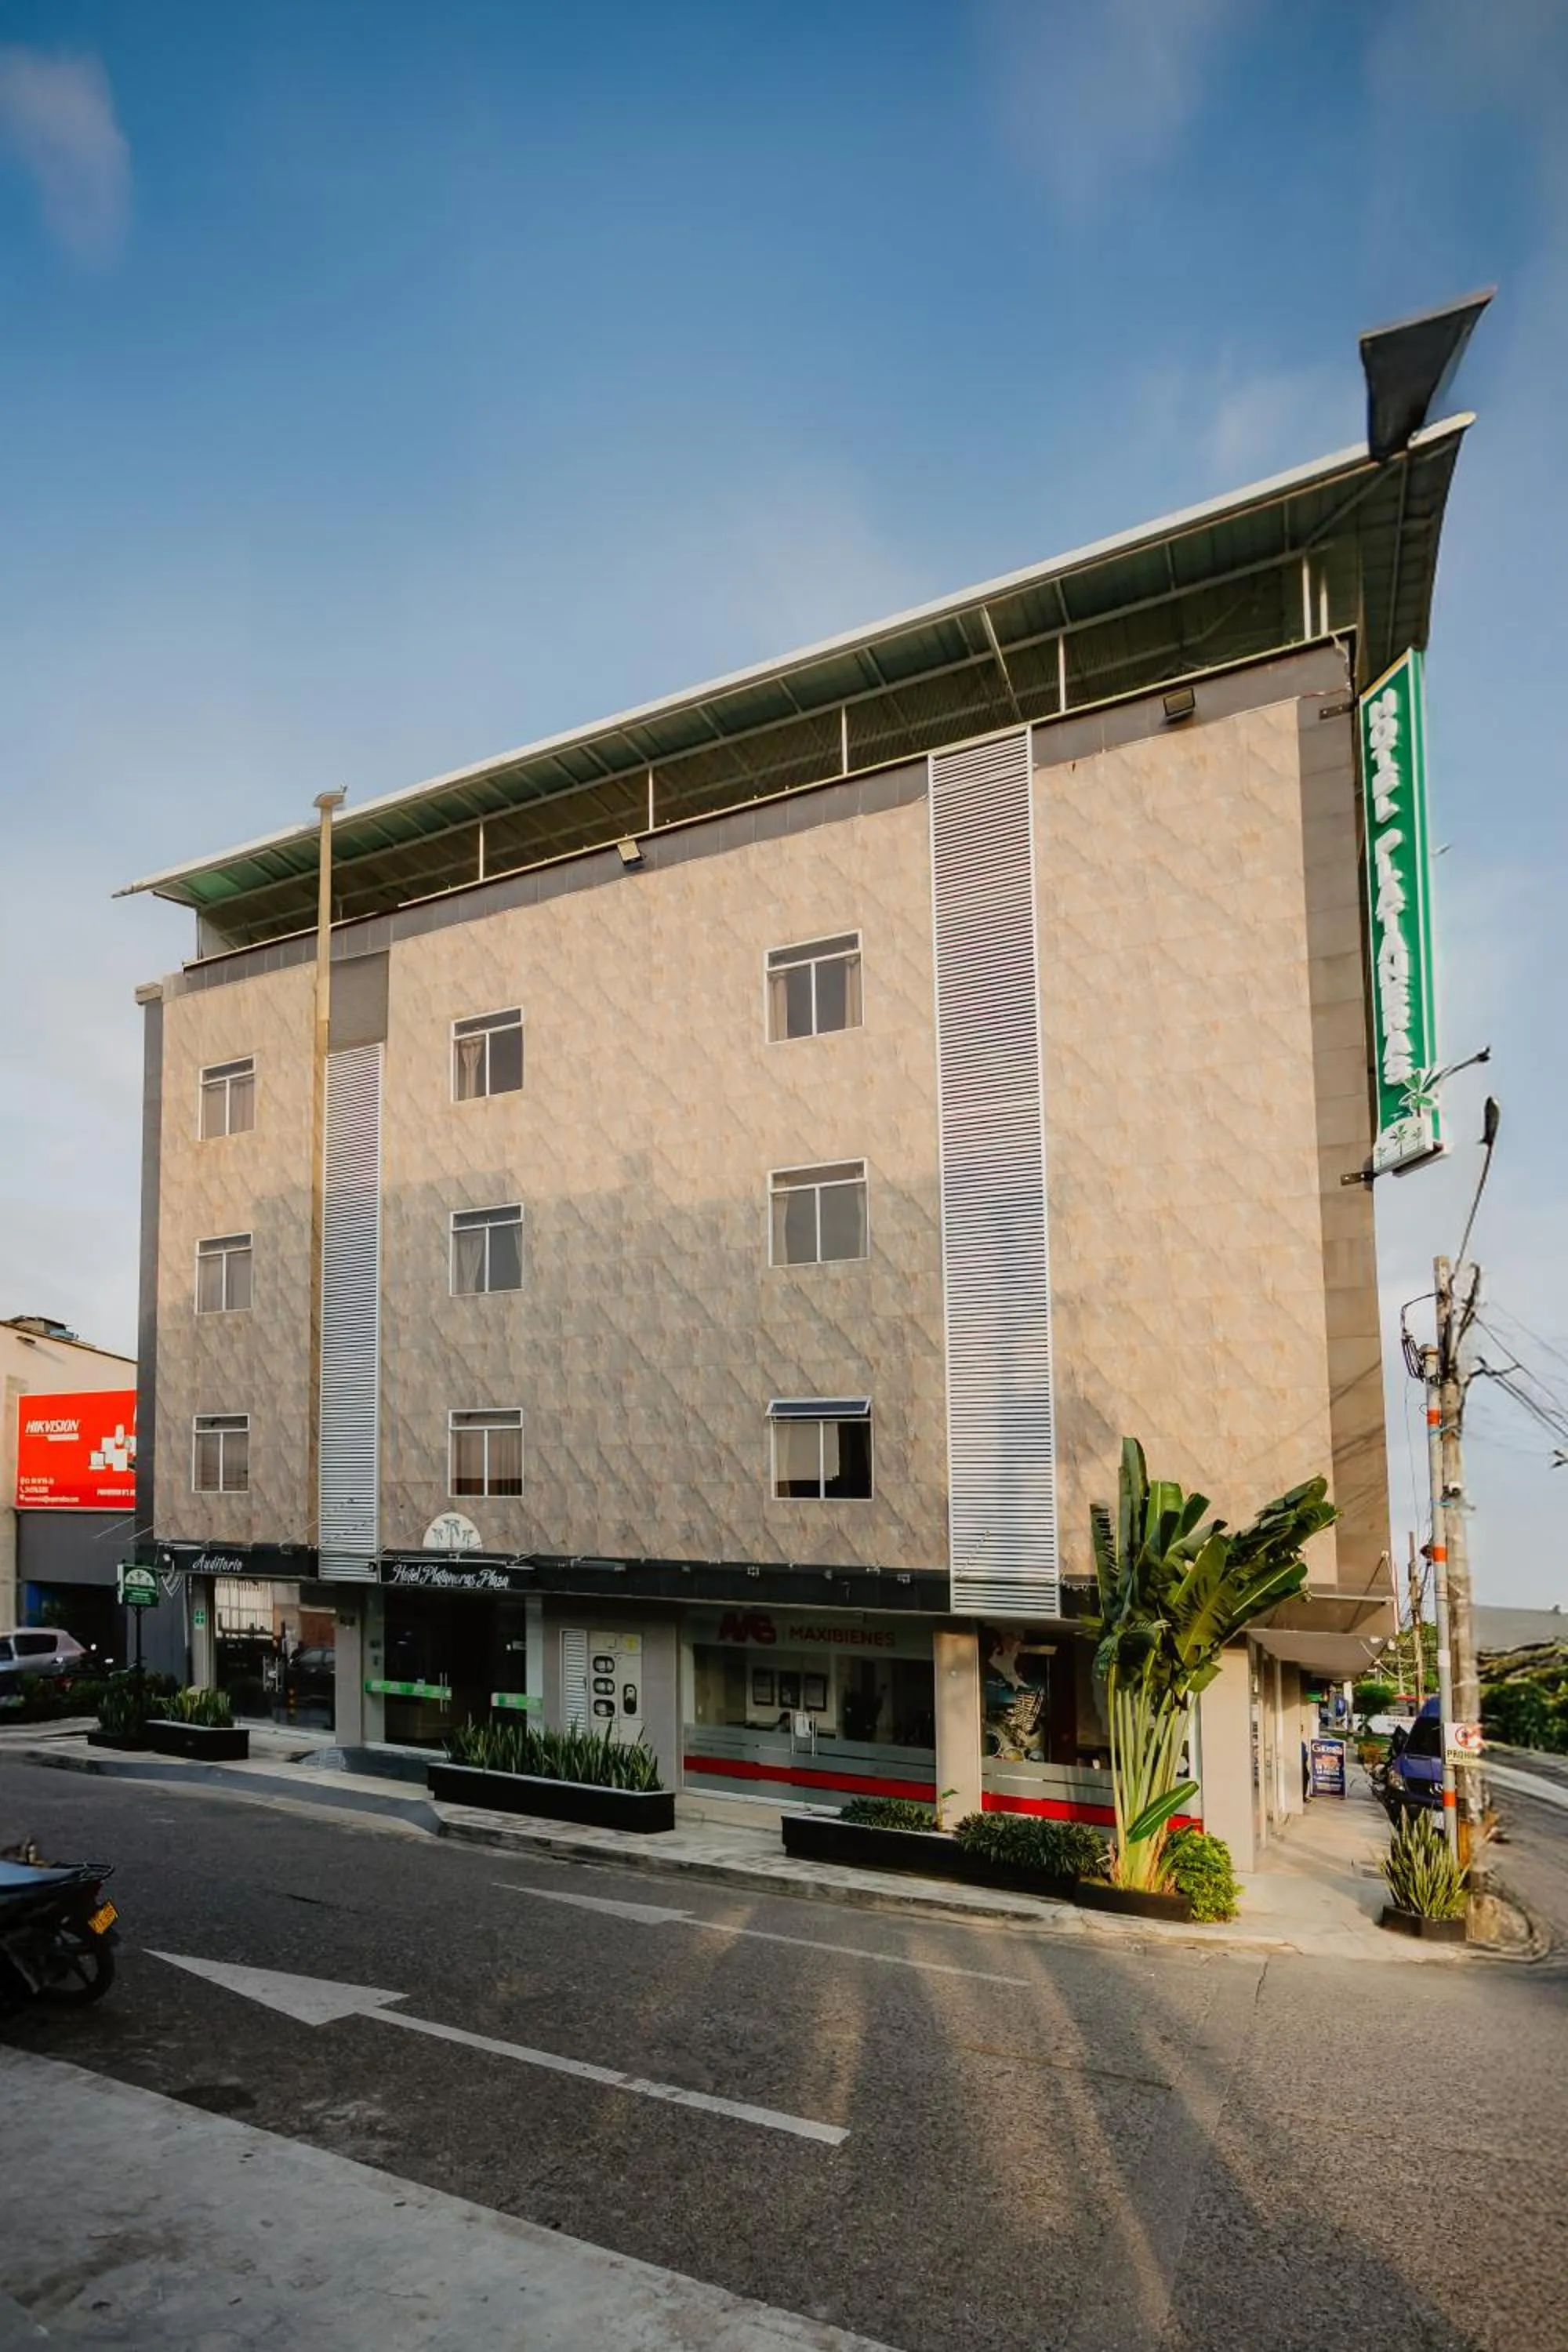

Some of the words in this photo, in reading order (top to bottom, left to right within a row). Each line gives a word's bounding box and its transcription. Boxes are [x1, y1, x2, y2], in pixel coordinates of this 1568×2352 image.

[1368, 687, 1400, 824] HOTEL
[25, 1419, 79, 1433] HIKVISION
[192, 1553, 243, 1572] Auditorio
[392, 1564, 421, 1583] Hotel
[476, 1569, 510, 1590] Plaza
[788, 1625, 896, 1646] MAXIBIENES
